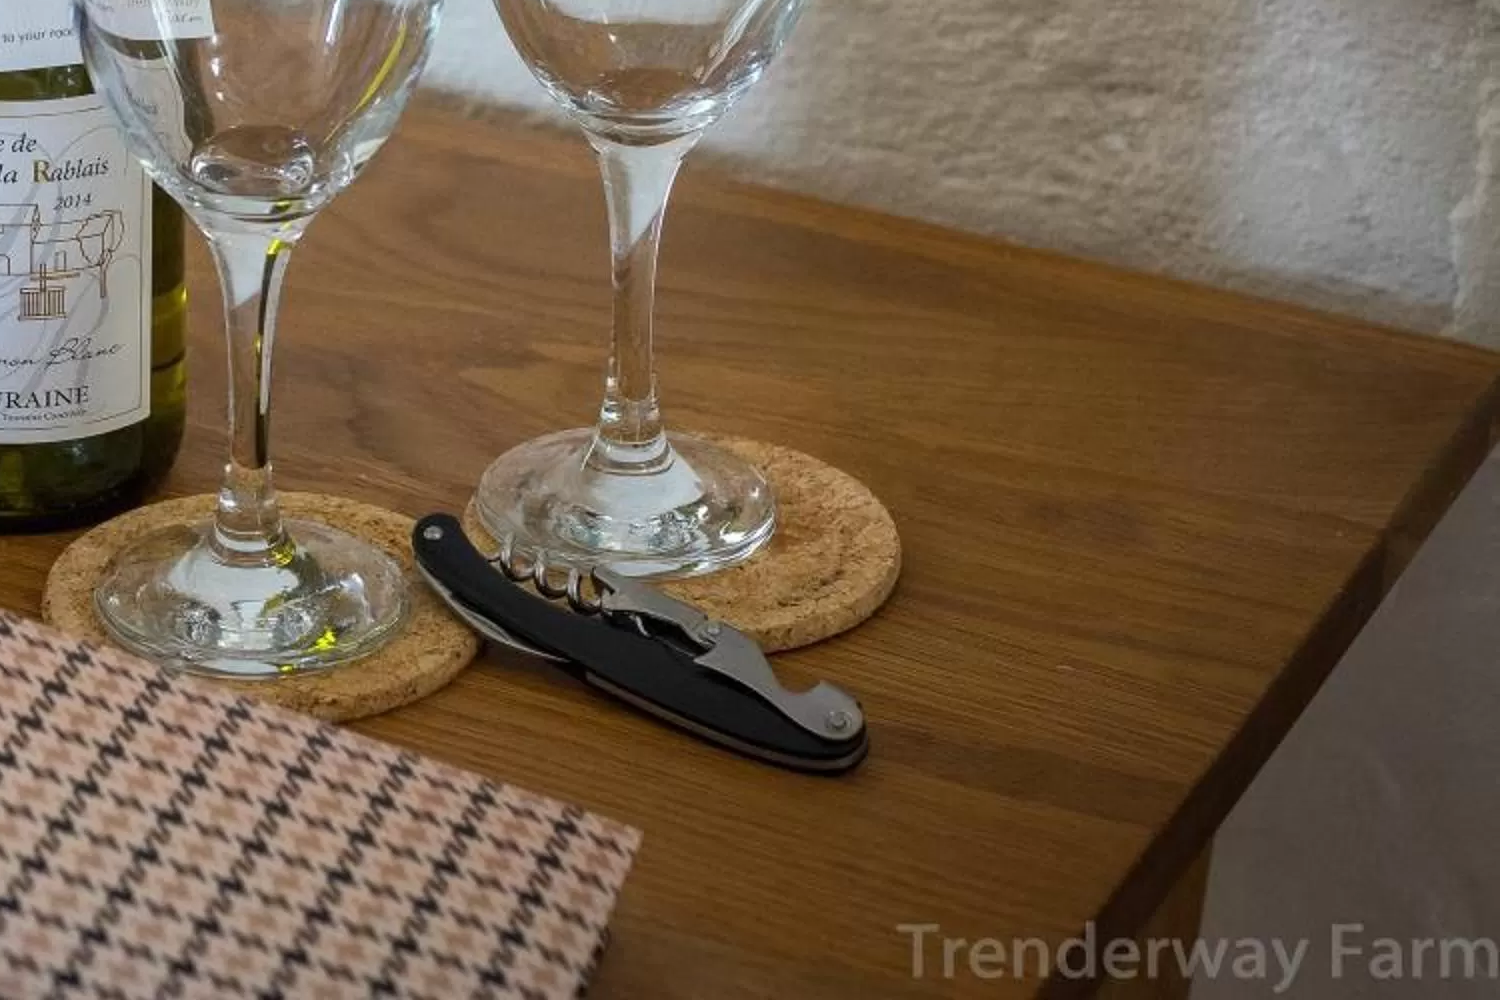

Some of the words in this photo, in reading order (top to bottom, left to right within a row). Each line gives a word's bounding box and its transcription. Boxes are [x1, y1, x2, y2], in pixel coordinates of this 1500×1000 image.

[2, 30, 15, 45] to
[19, 29, 46, 46] your
[11, 132, 37, 153] de
[32, 157, 110, 184] Rablais
[54, 194, 94, 211] 2014
[43, 336, 126, 367] Blanc
